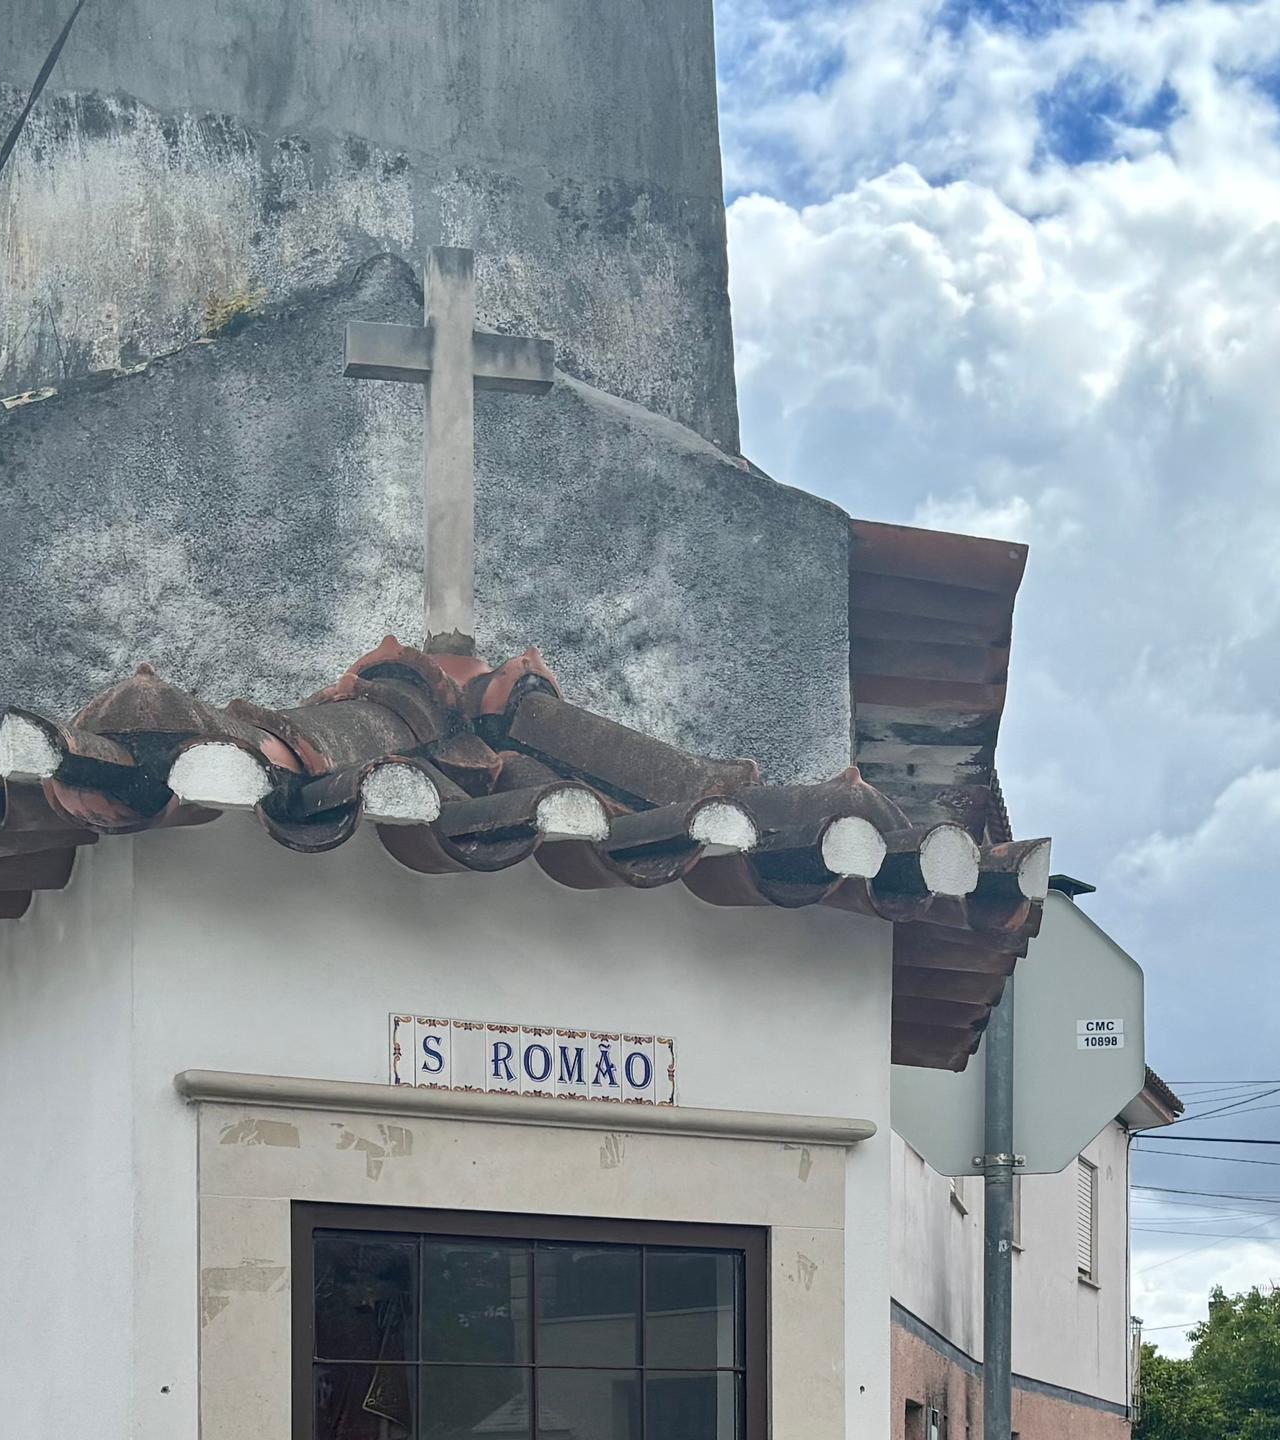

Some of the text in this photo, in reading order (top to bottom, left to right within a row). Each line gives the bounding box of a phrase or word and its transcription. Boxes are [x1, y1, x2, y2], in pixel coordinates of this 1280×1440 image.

[1085, 1021, 1115, 1032] CMC
[1083, 1036, 1118, 1047] 10898
[421, 1034, 654, 1089] S ROMÃO
